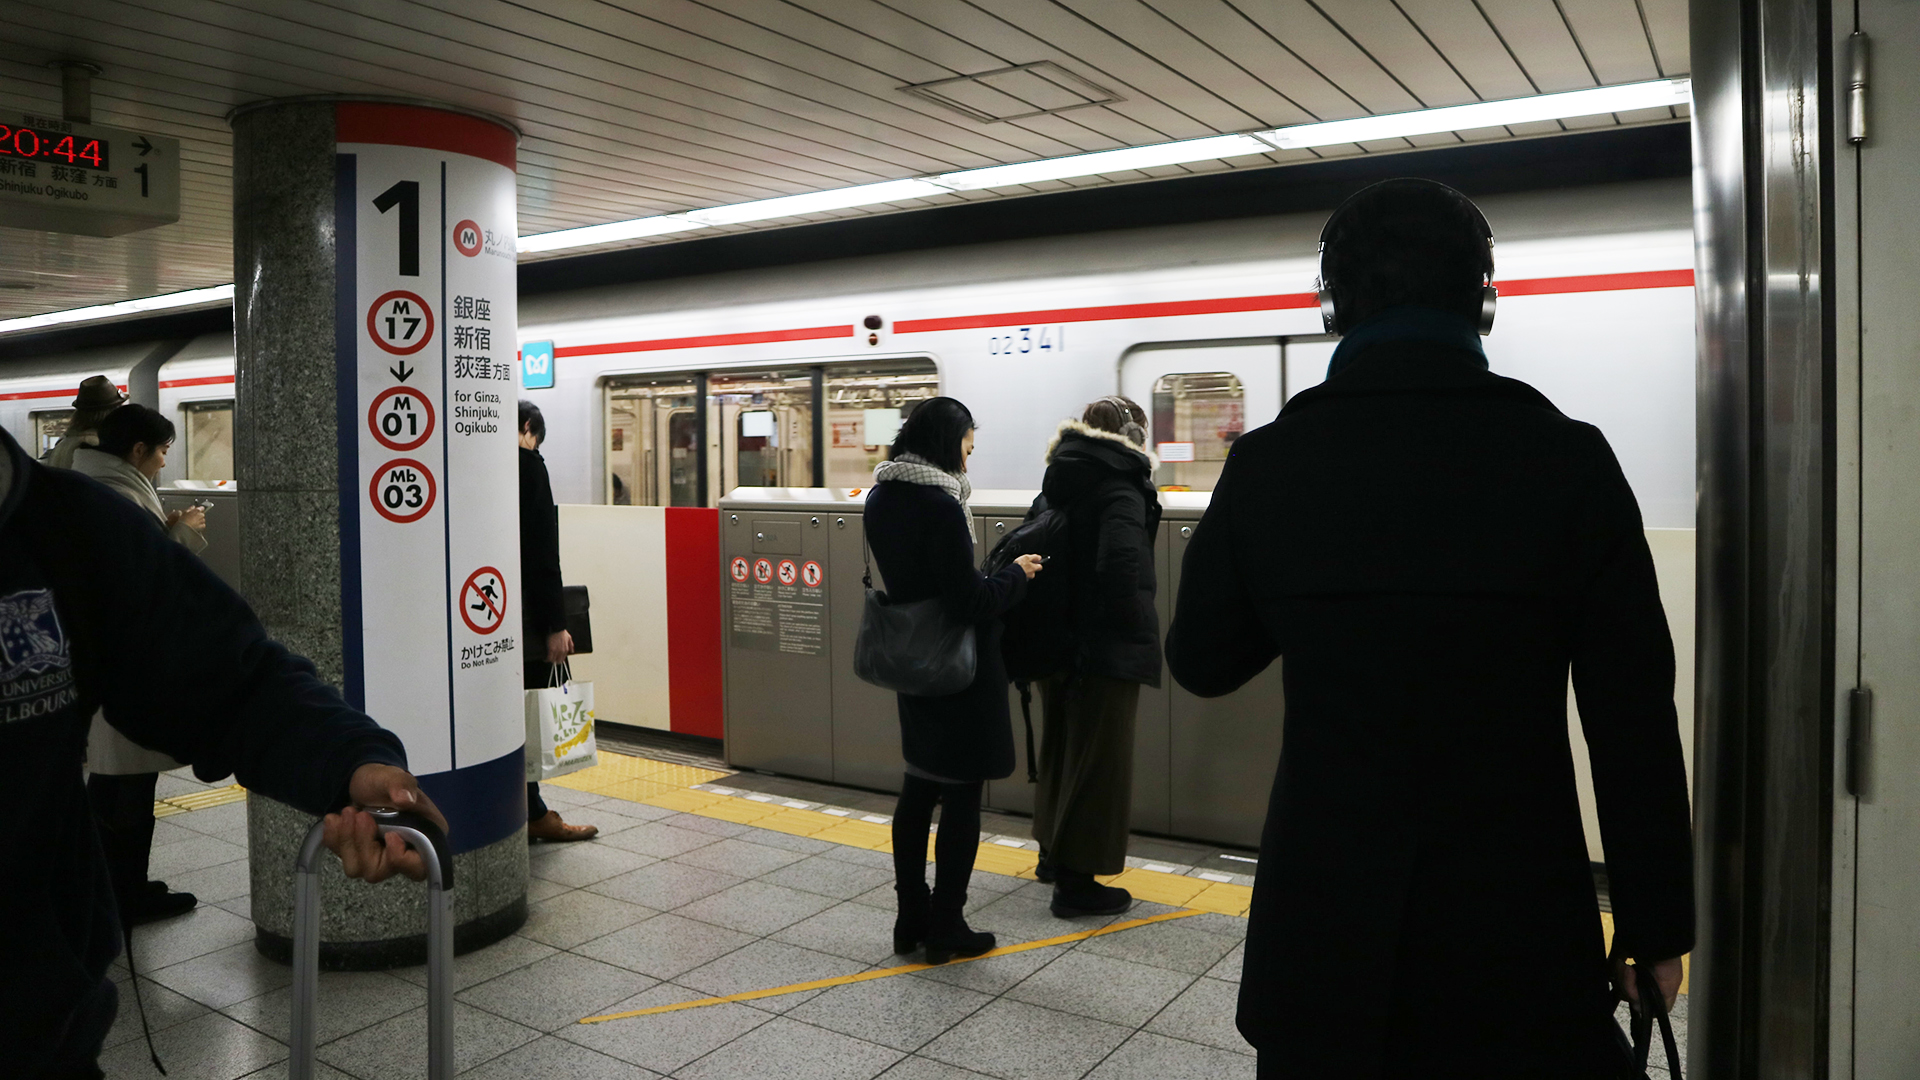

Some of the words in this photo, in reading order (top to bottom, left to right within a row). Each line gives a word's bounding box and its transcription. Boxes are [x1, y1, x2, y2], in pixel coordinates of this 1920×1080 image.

[0, 157, 36, 178] 新宿
[134, 163, 149, 198] 1
[45, 185, 89, 201] Ogikubo
[372, 180, 420, 277] 1
[462, 231, 476, 246] M
[392, 300, 410, 315] M
[454, 295, 491, 322] 銀座
[385, 317, 421, 340] 17
[454, 325, 491, 351] 新宿
[393, 396, 411, 411] M
[455, 390, 472, 403] for
[474, 391, 502, 404] Ginza,
[455, 406, 500, 421] Shinjuku,
[382, 413, 417, 437] 01
[455, 422, 498, 437] Ogikubo
[390, 469, 417, 483] Mb
[384, 484, 423, 509] 03
[461, 637, 515, 661] かけこみ禁止
[461, 661, 472, 670] Do
[472, 659, 485, 668] Not
[485, 655, 499, 665] Rush
